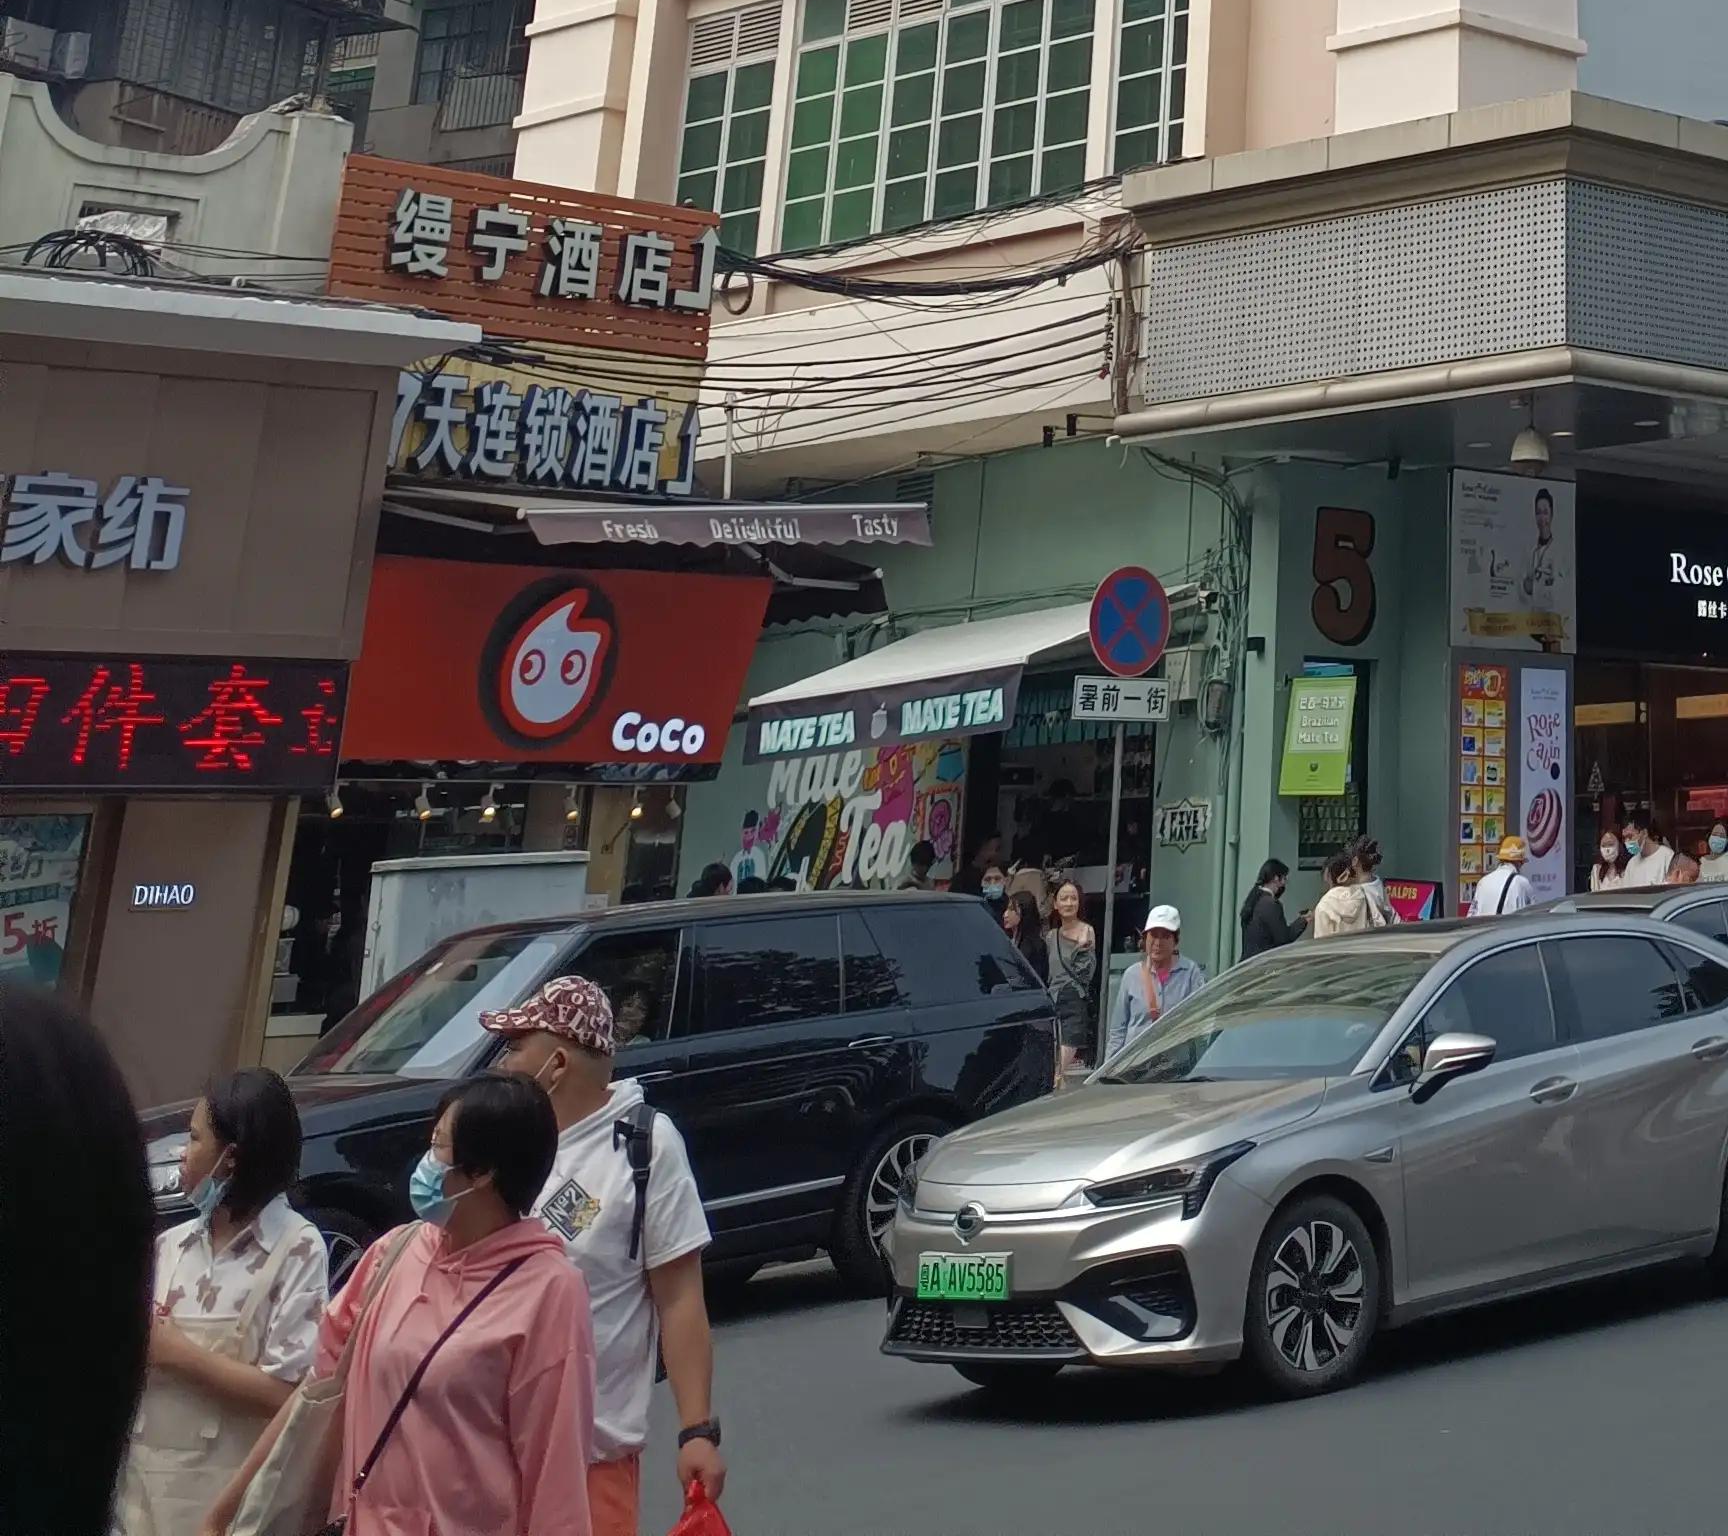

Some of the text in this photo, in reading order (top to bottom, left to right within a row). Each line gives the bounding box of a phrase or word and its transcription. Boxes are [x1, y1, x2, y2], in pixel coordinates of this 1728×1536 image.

[390, 188, 675, 308] 缦宁酒店
[387, 371, 667, 491] 7天连锁酒店
[0, 472, 190, 570] 家纺
[602, 513, 898, 540] Fresh Delightful Tasty
[1311, 506, 1377, 646] 5
[1670, 553, 1723, 586] Rose
[612, 712, 705, 755] CoCo
[759, 710, 855, 755] MATE TEA
[900, 687, 1004, 736] MATE TEA
[840, 789, 911, 884] Tea
[1169, 825, 1199, 842] MATE
[1170, 809, 1199, 825] FIVE
[133, 884, 194, 907] DIHAO
